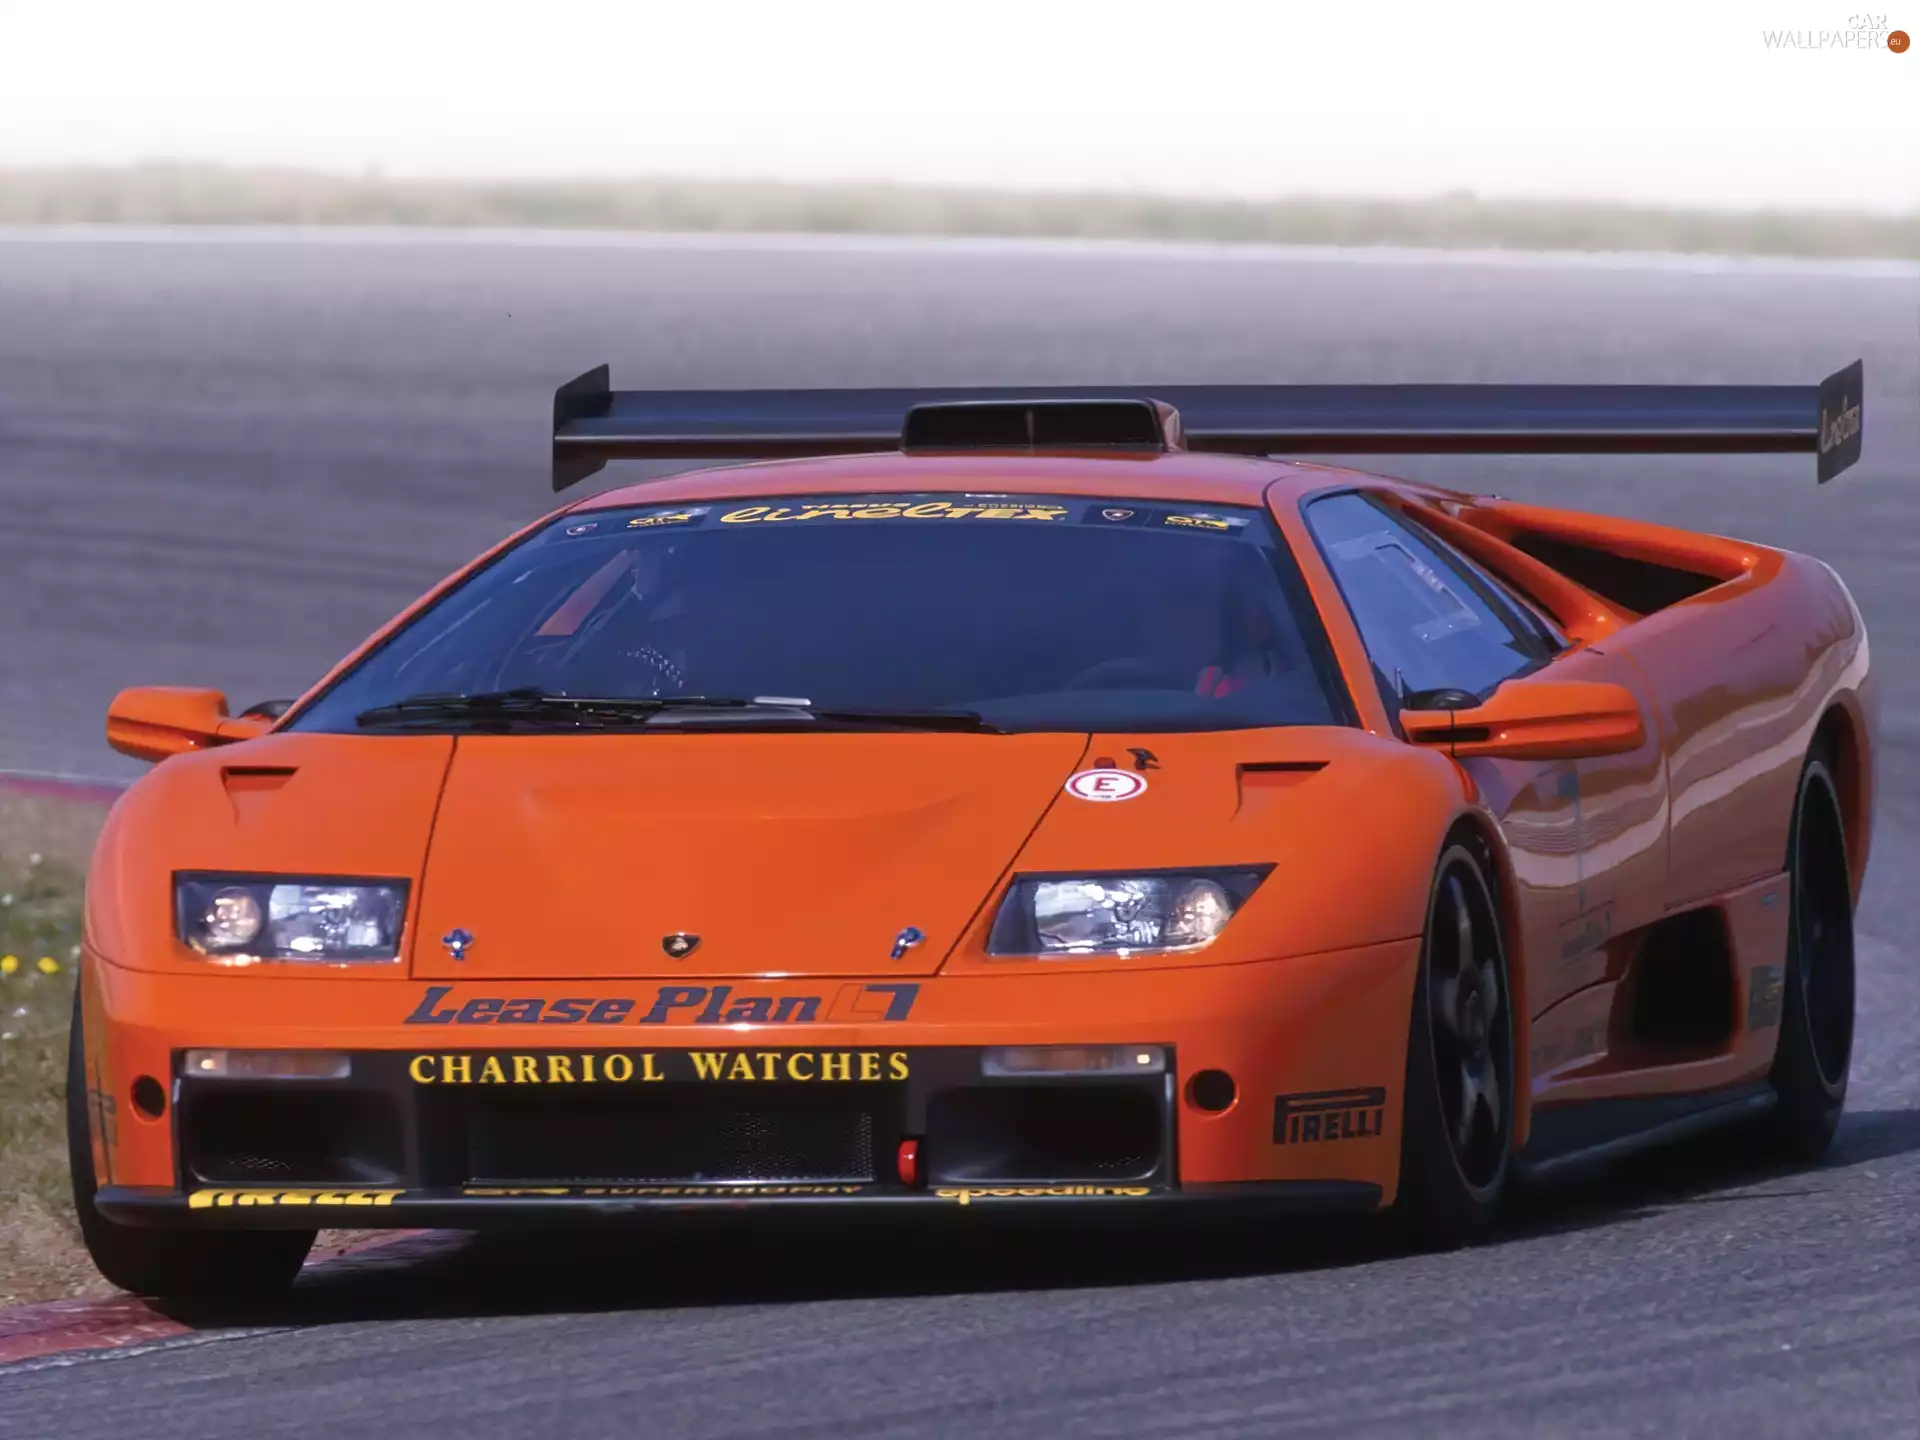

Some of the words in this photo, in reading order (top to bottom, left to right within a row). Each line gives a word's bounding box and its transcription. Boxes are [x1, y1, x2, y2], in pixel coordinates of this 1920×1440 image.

[1094, 777, 1119, 791] E
[402, 986, 639, 1024] Lease
[640, 986, 824, 1023] Plan
[408, 1053, 665, 1084] CHARRIOL
[688, 1051, 909, 1081] WATCHES
[1273, 1086, 1386, 1145] PIRELLI
